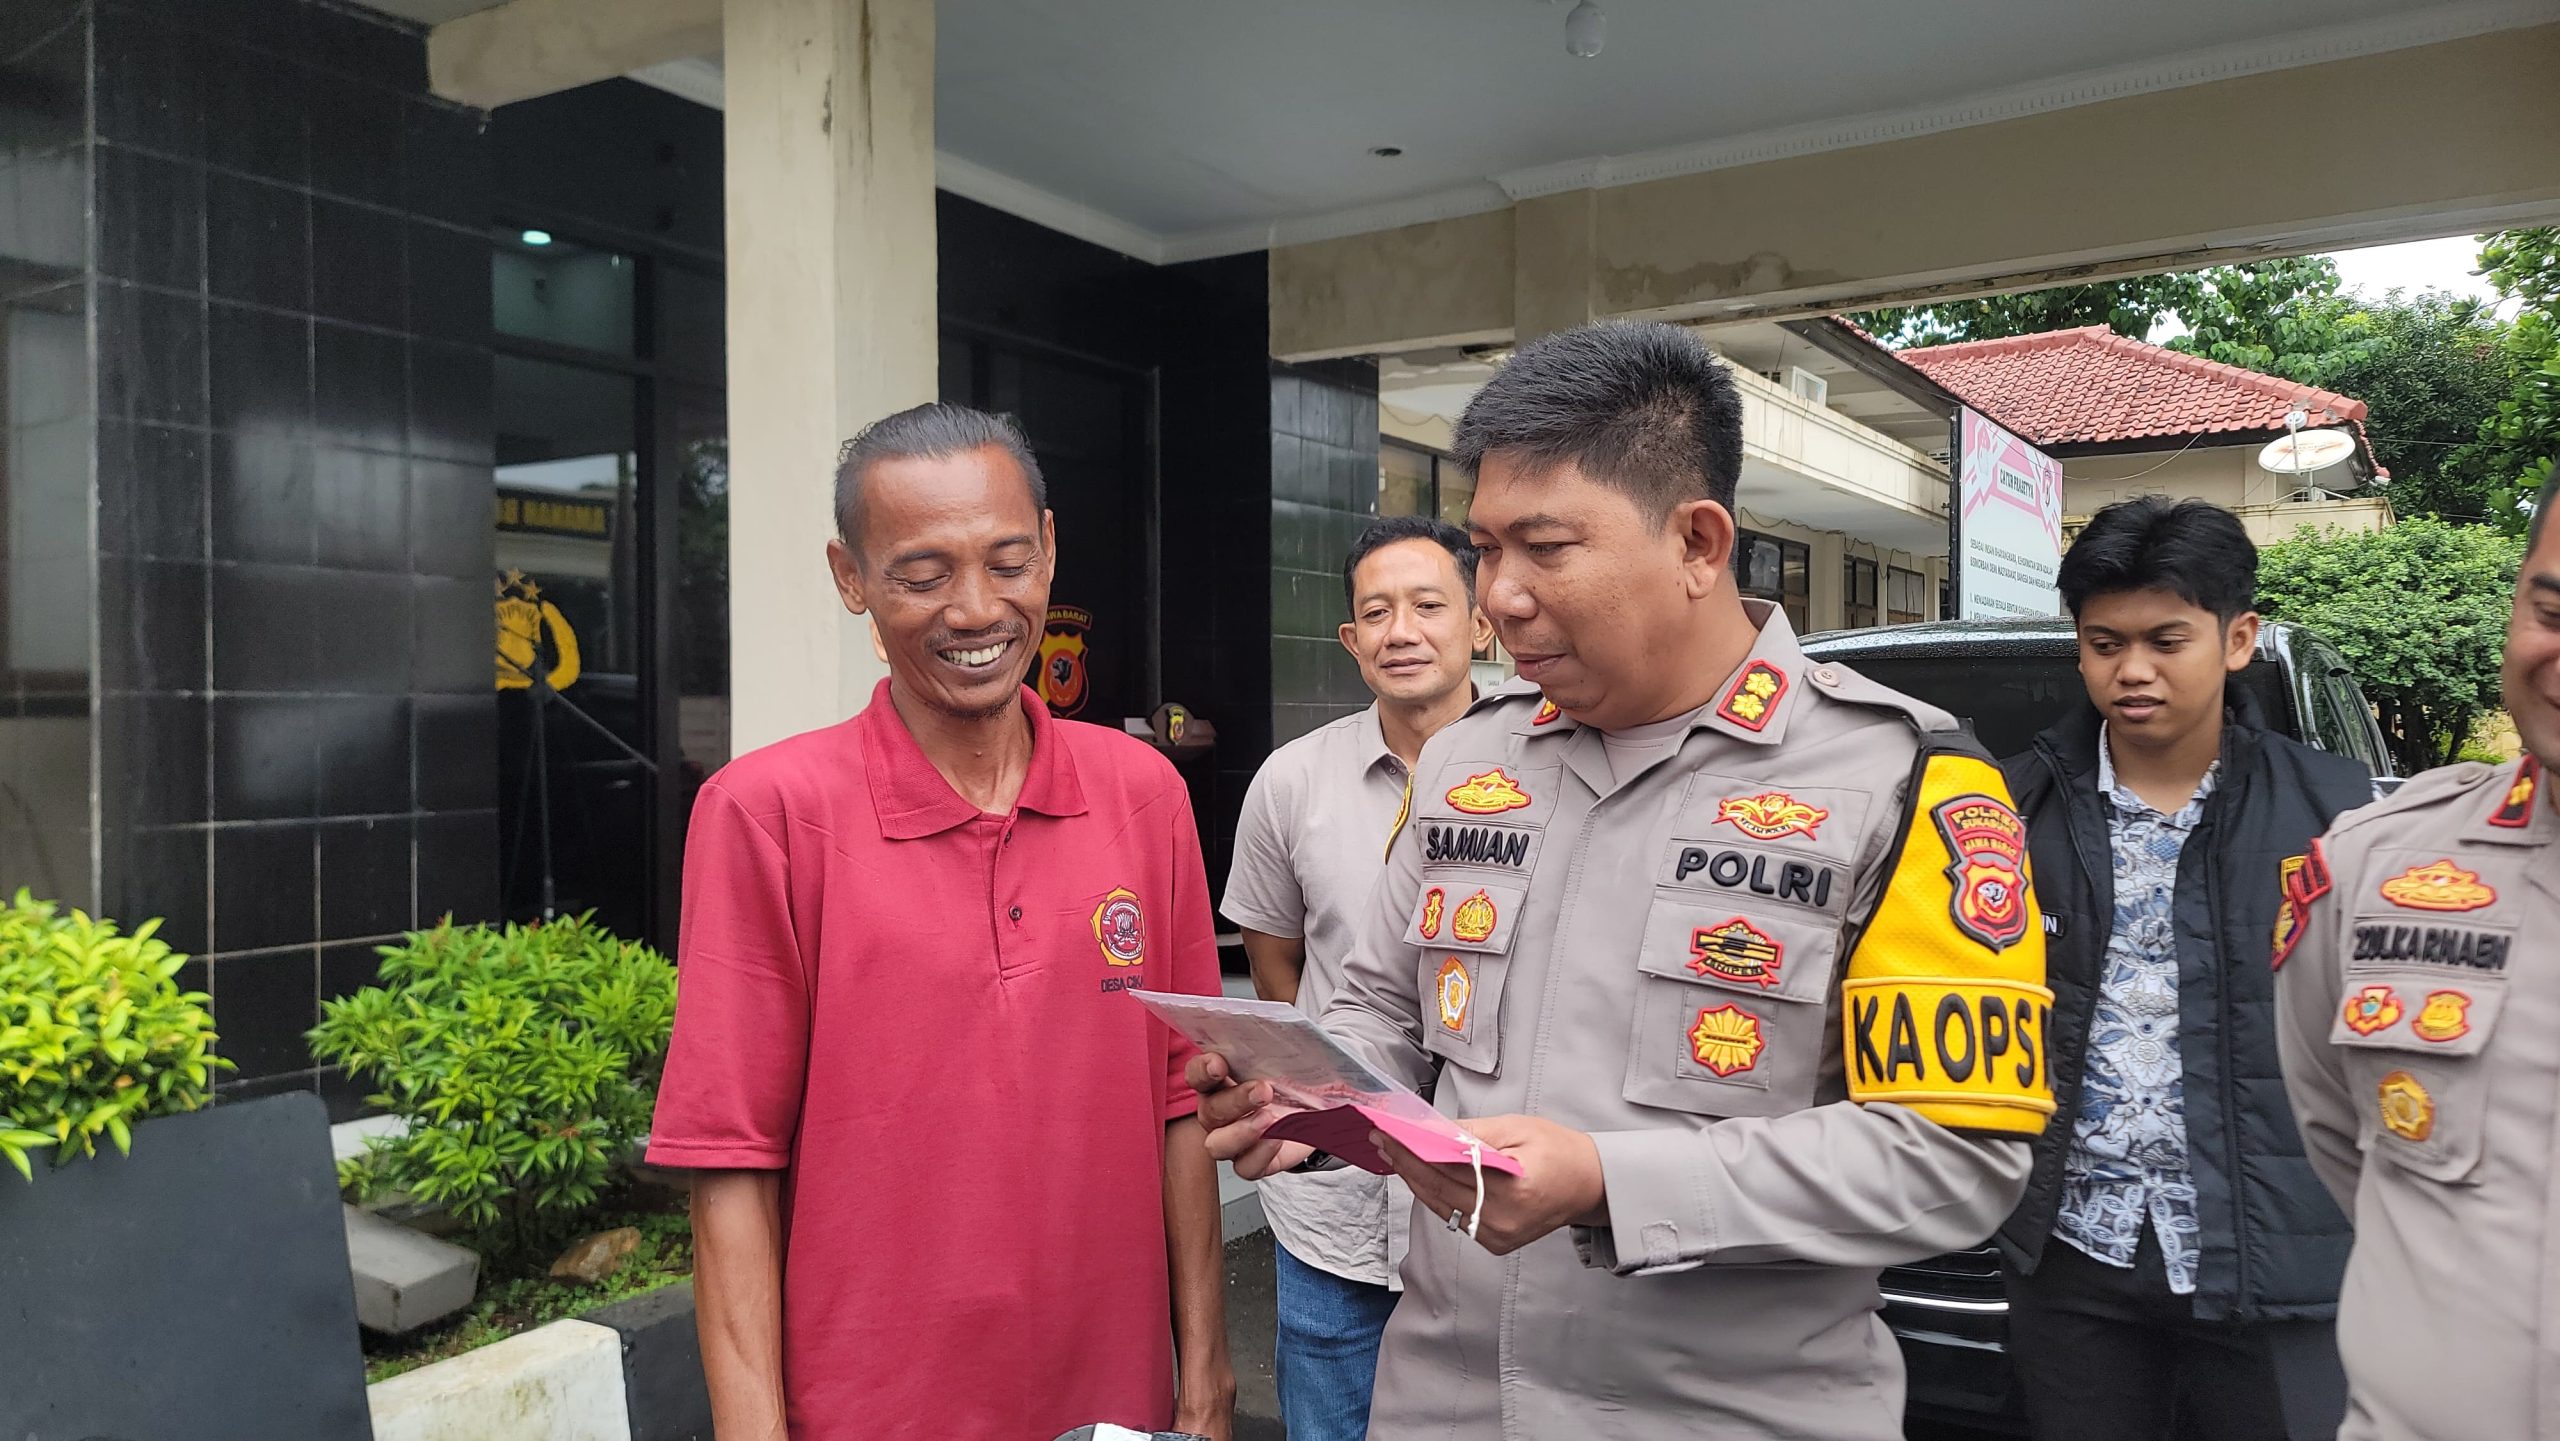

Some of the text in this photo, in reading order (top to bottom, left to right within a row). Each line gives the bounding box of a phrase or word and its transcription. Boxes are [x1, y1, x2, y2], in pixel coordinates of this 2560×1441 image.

[1046, 610, 1088, 624] AWA BARAT
[1426, 826, 1530, 867] SAMIAN
[1675, 847, 1832, 907] POLRI
[1101, 977, 1126, 993] DESA
[1853, 991, 1924, 1084] KA
